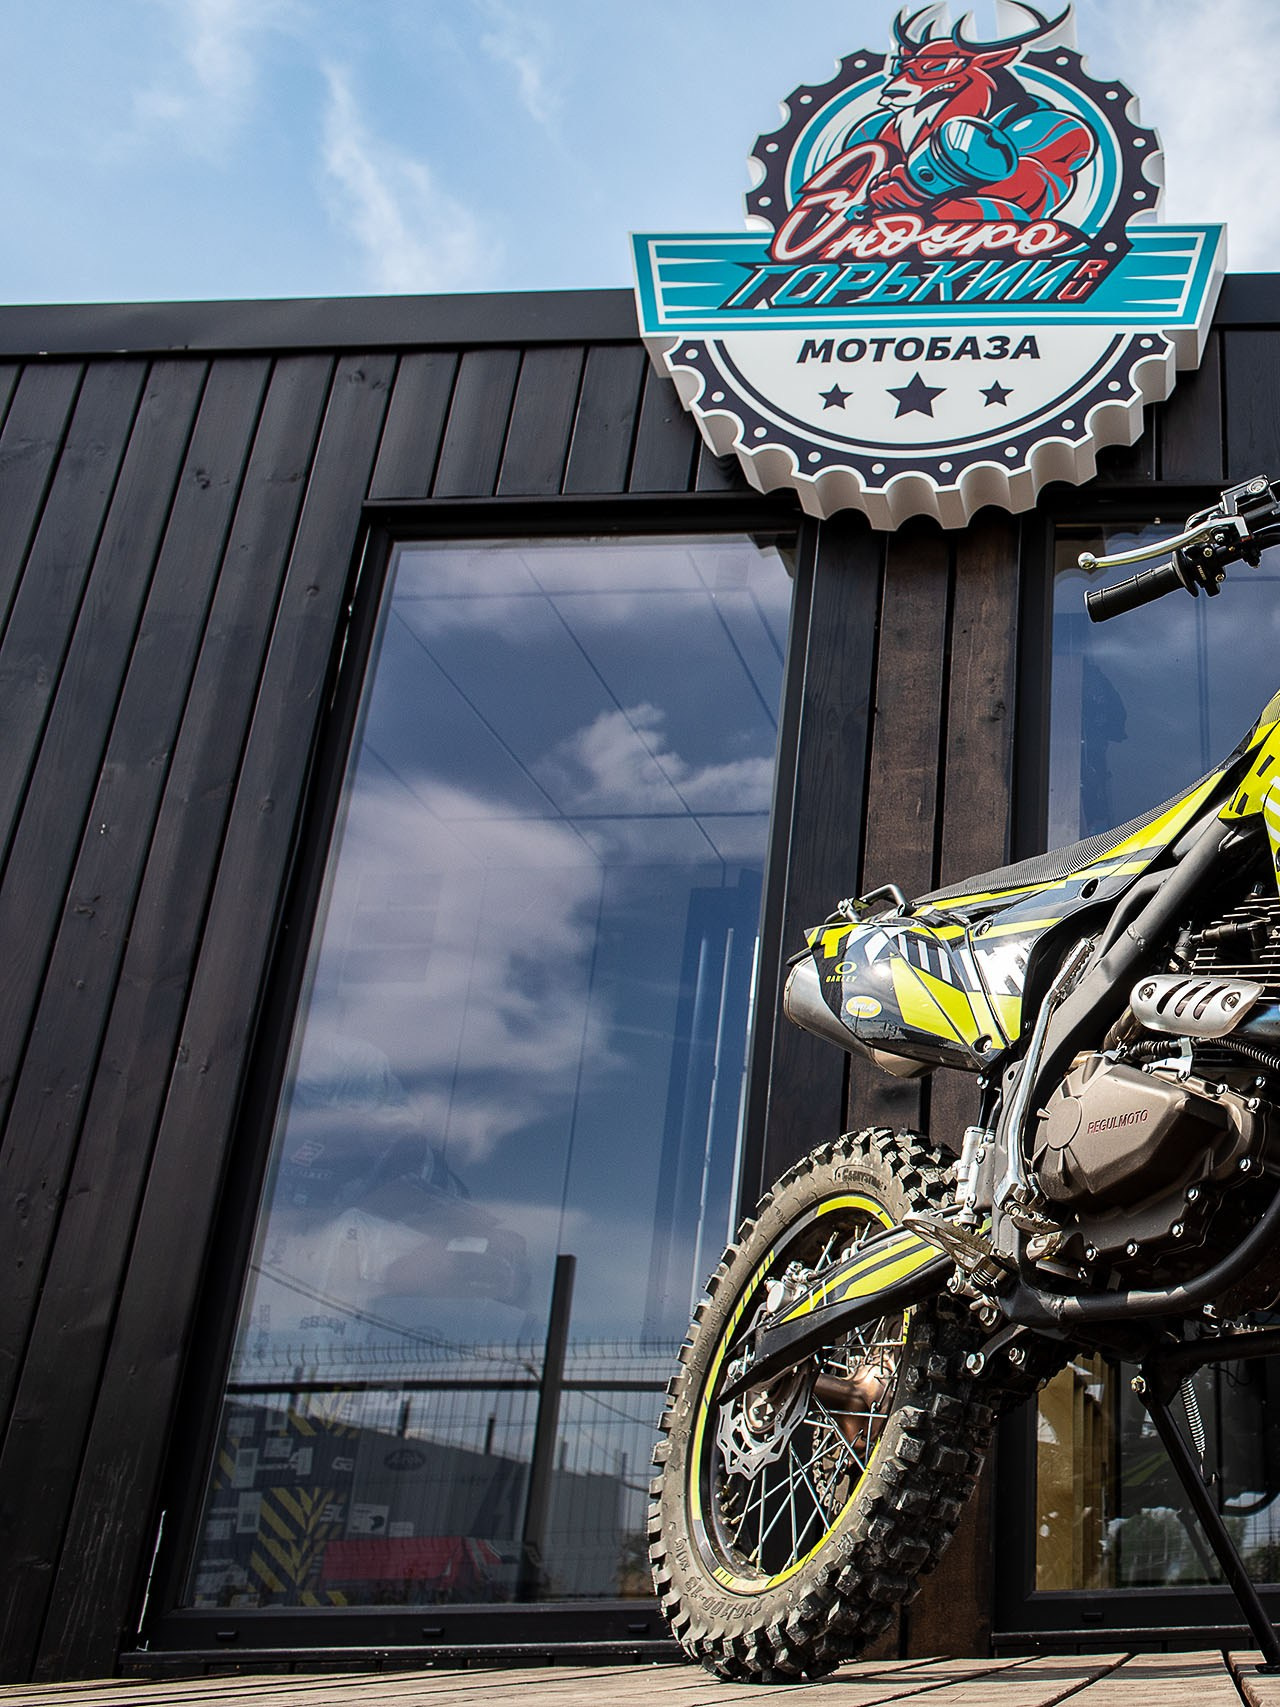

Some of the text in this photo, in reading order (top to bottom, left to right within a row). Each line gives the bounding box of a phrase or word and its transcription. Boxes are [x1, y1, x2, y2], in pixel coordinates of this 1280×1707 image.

[771, 141, 1073, 261] Эндуро
[727, 243, 1091, 307] ГОРЬКИЙ
[796, 335, 1041, 363] МОТОБАЗА
[825, 975, 858, 983] OAKLEY
[1086, 1108, 1149, 1135] REGULMOTO
